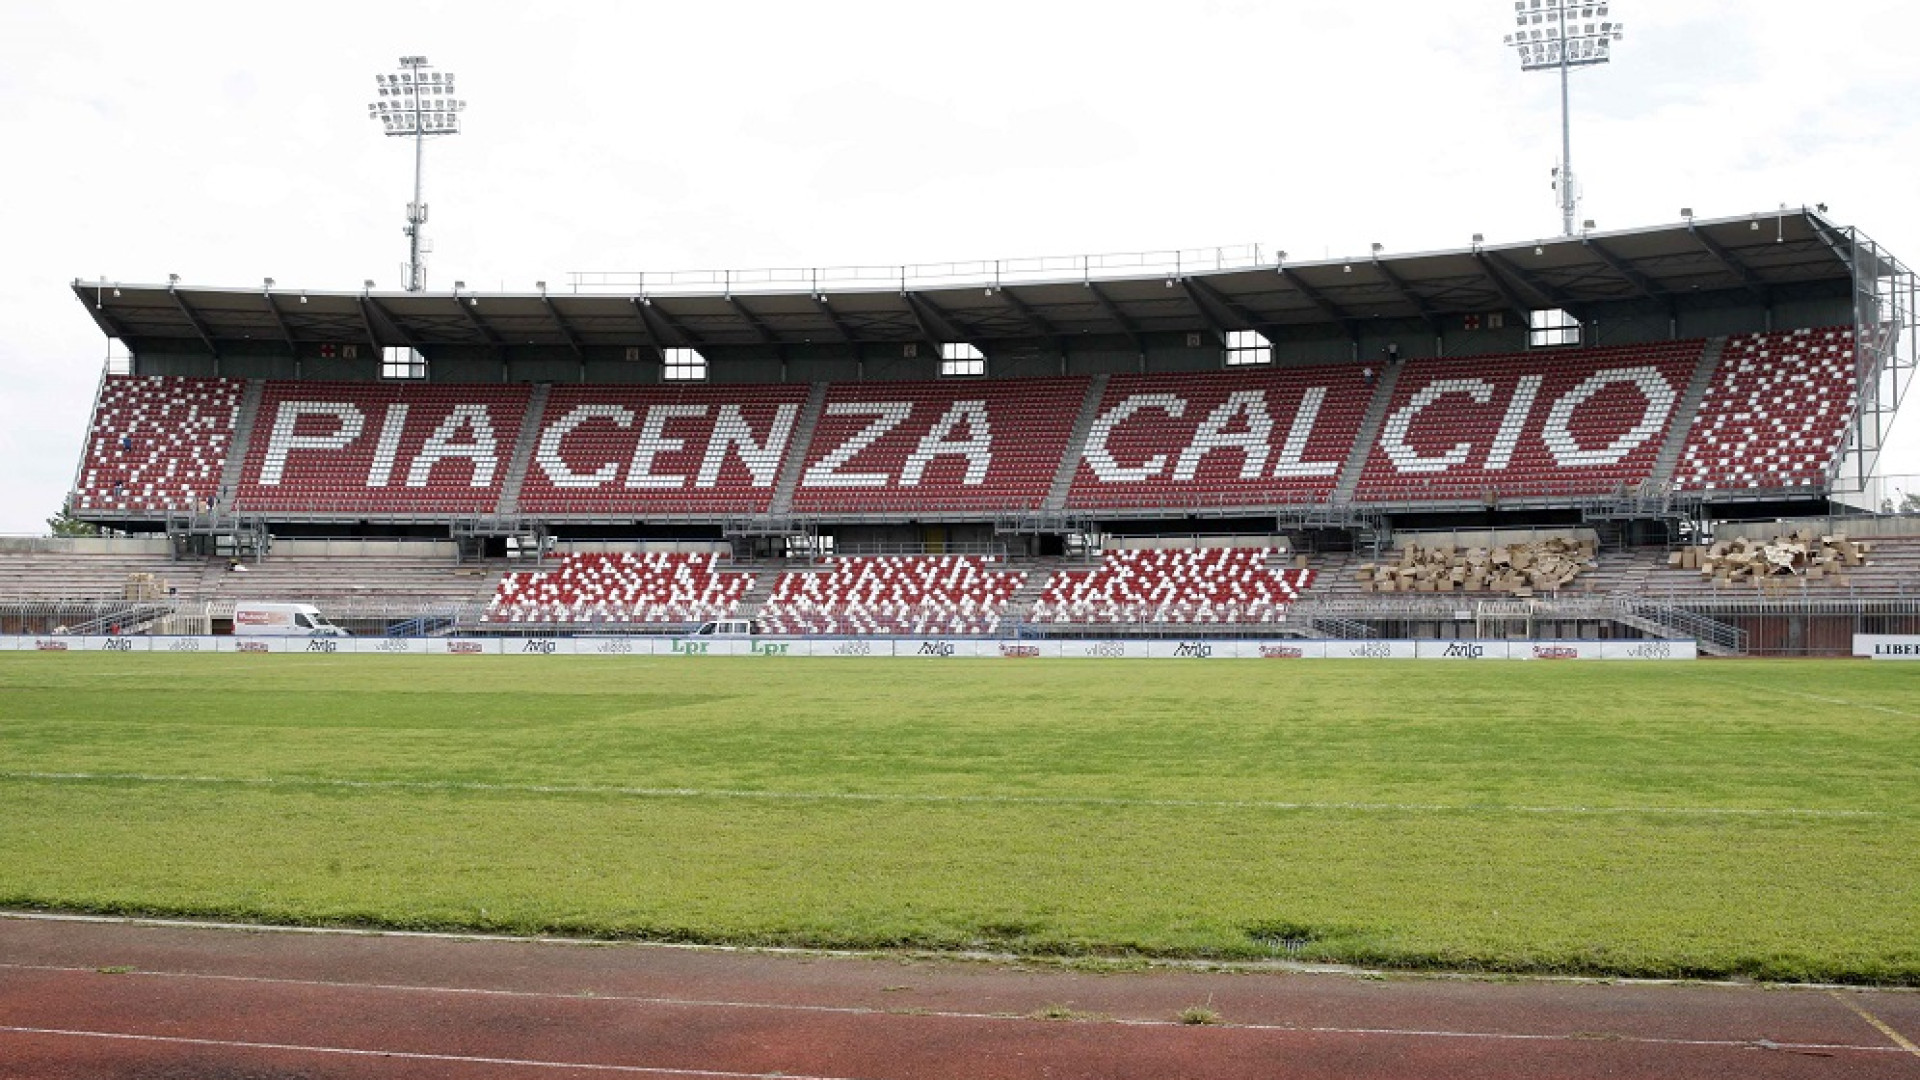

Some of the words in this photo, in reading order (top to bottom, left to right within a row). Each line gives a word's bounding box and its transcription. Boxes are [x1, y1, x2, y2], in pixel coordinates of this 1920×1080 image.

[258, 398, 993, 489] PIACENZA
[1083, 365, 1678, 484] CALCIO
[671, 637, 710, 657] Lpr
[750, 638, 789, 657] Lpr
